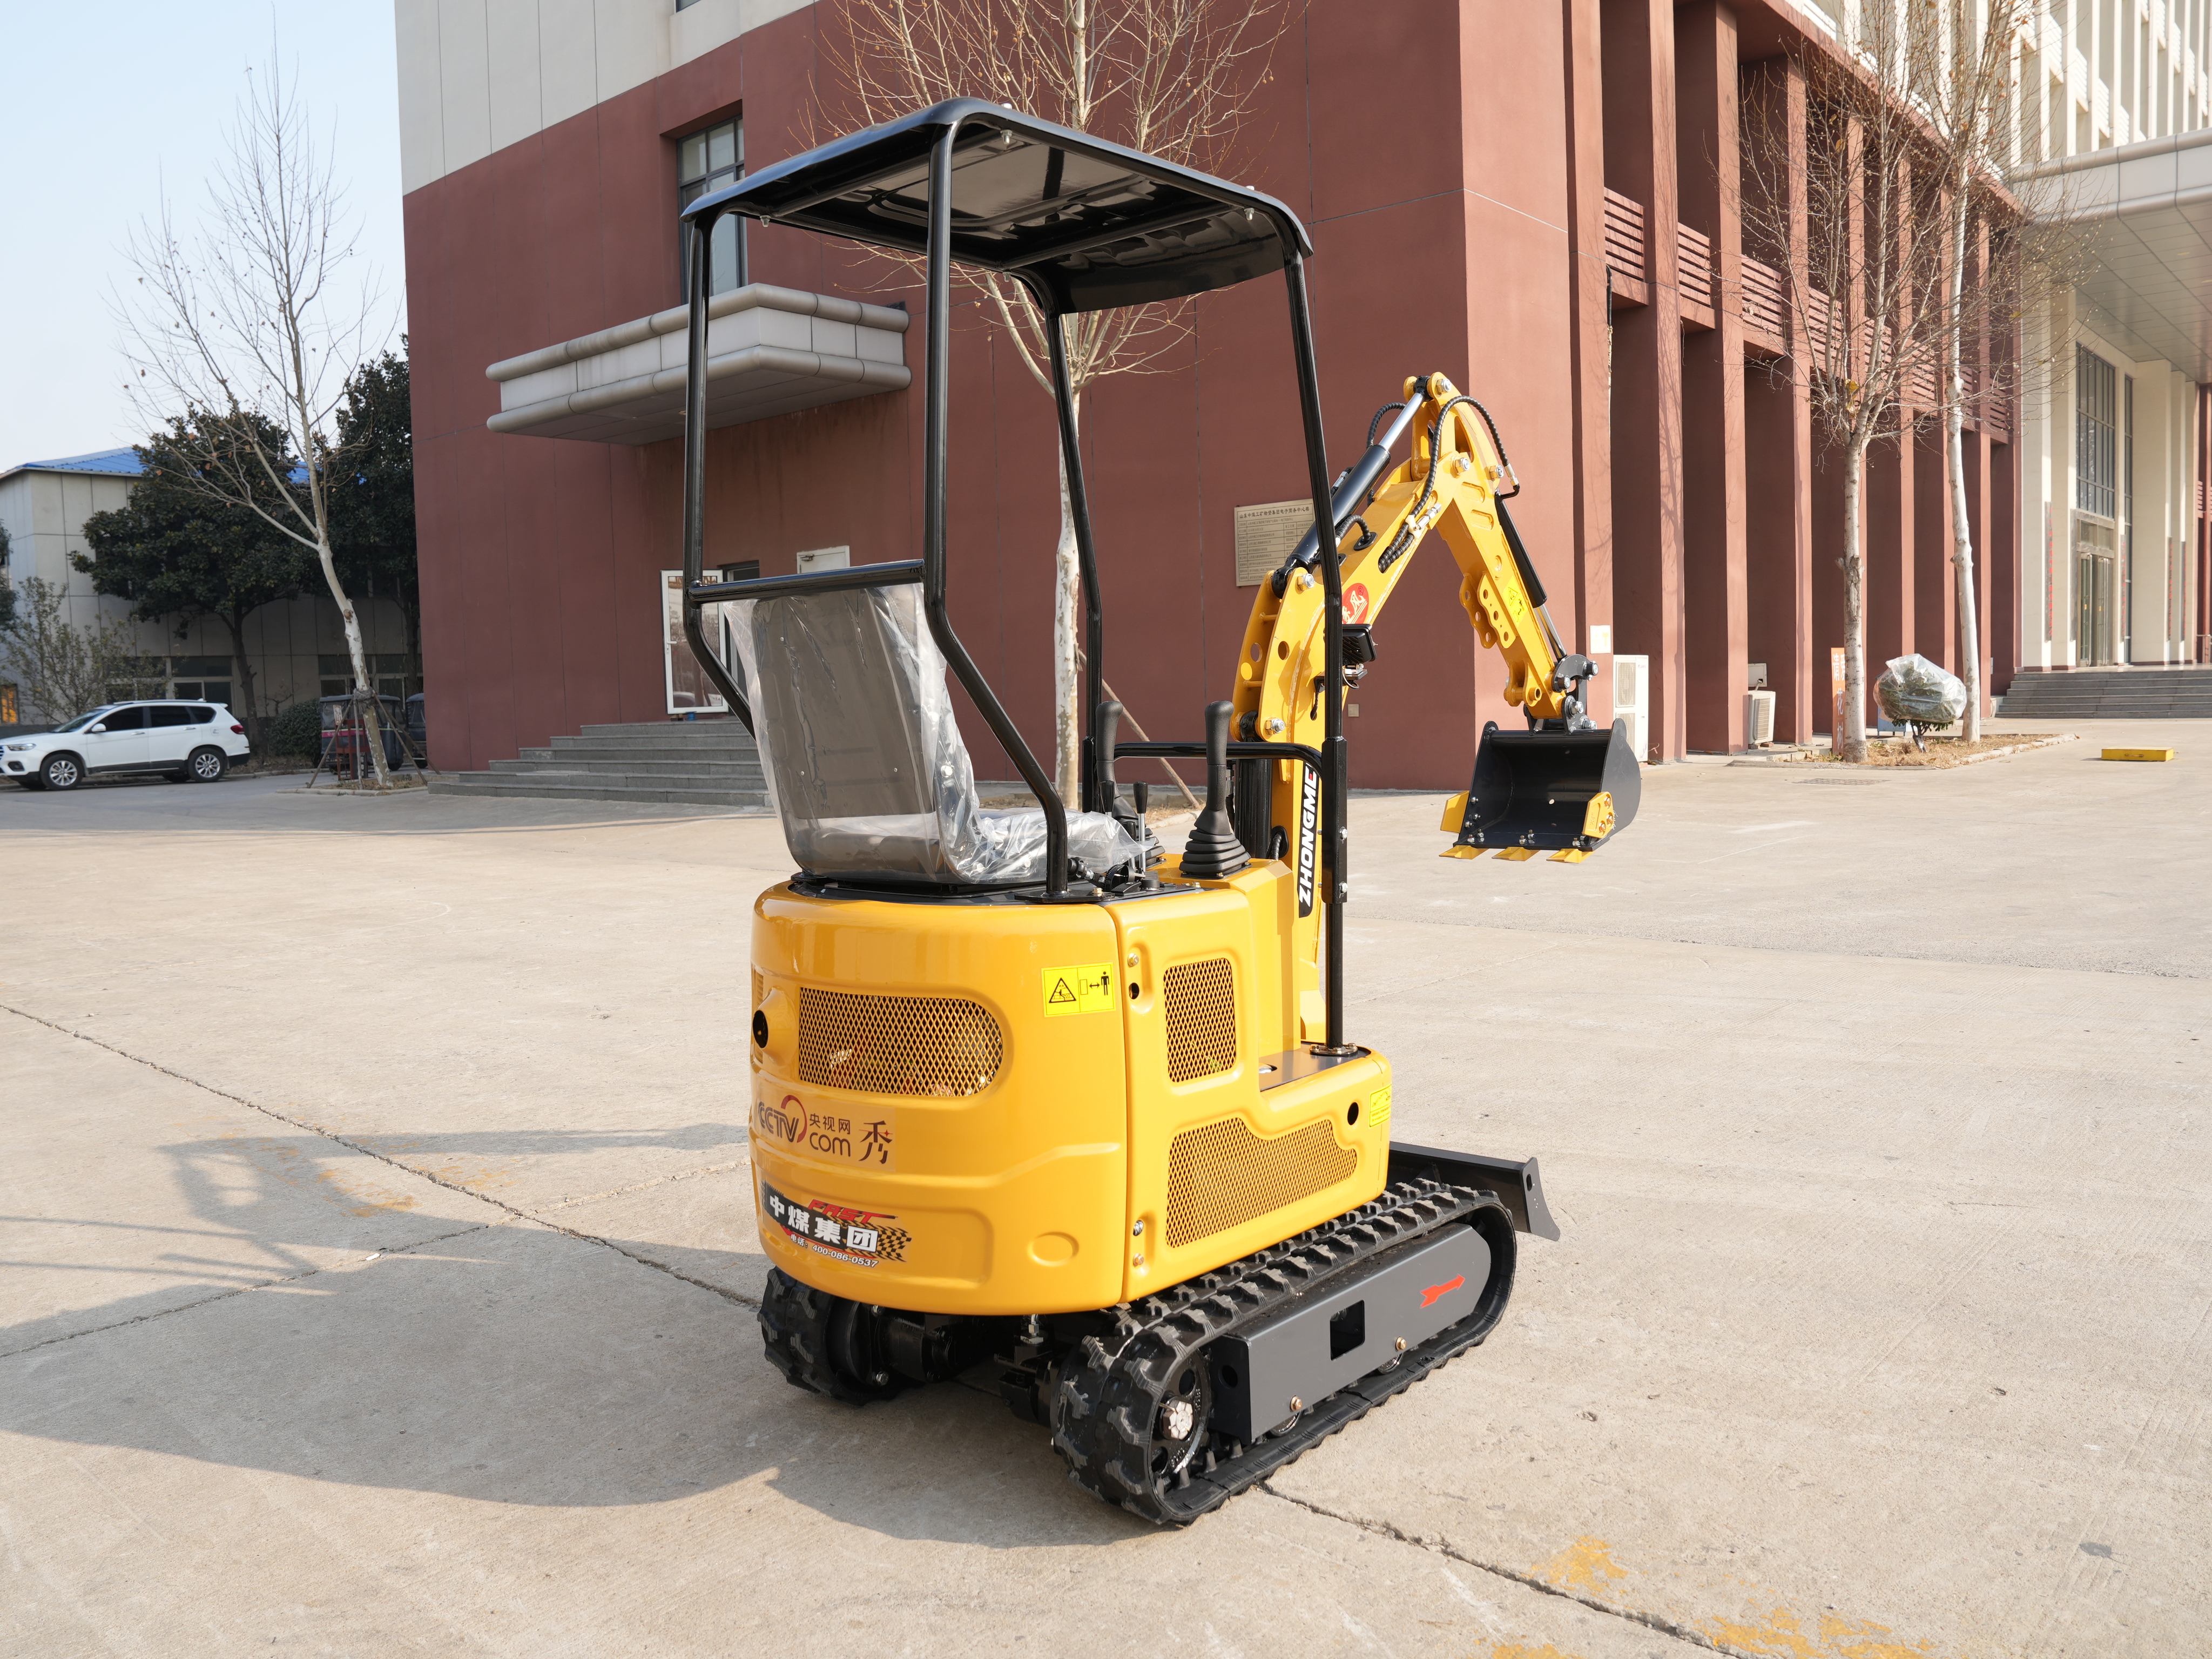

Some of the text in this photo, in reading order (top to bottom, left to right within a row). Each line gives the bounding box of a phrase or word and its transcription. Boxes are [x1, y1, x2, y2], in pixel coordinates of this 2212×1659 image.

[1299, 762, 1318, 907] ZHONGME
[758, 1101, 799, 1143] CCTV
[809, 1113, 851, 1135] 央视网
[858, 1120, 893, 1164] 秀
[770, 1195, 879, 1253] 中煤集团
[808, 1198, 895, 1224] FAST
[812, 1244, 879, 1268] 400-086-0537
